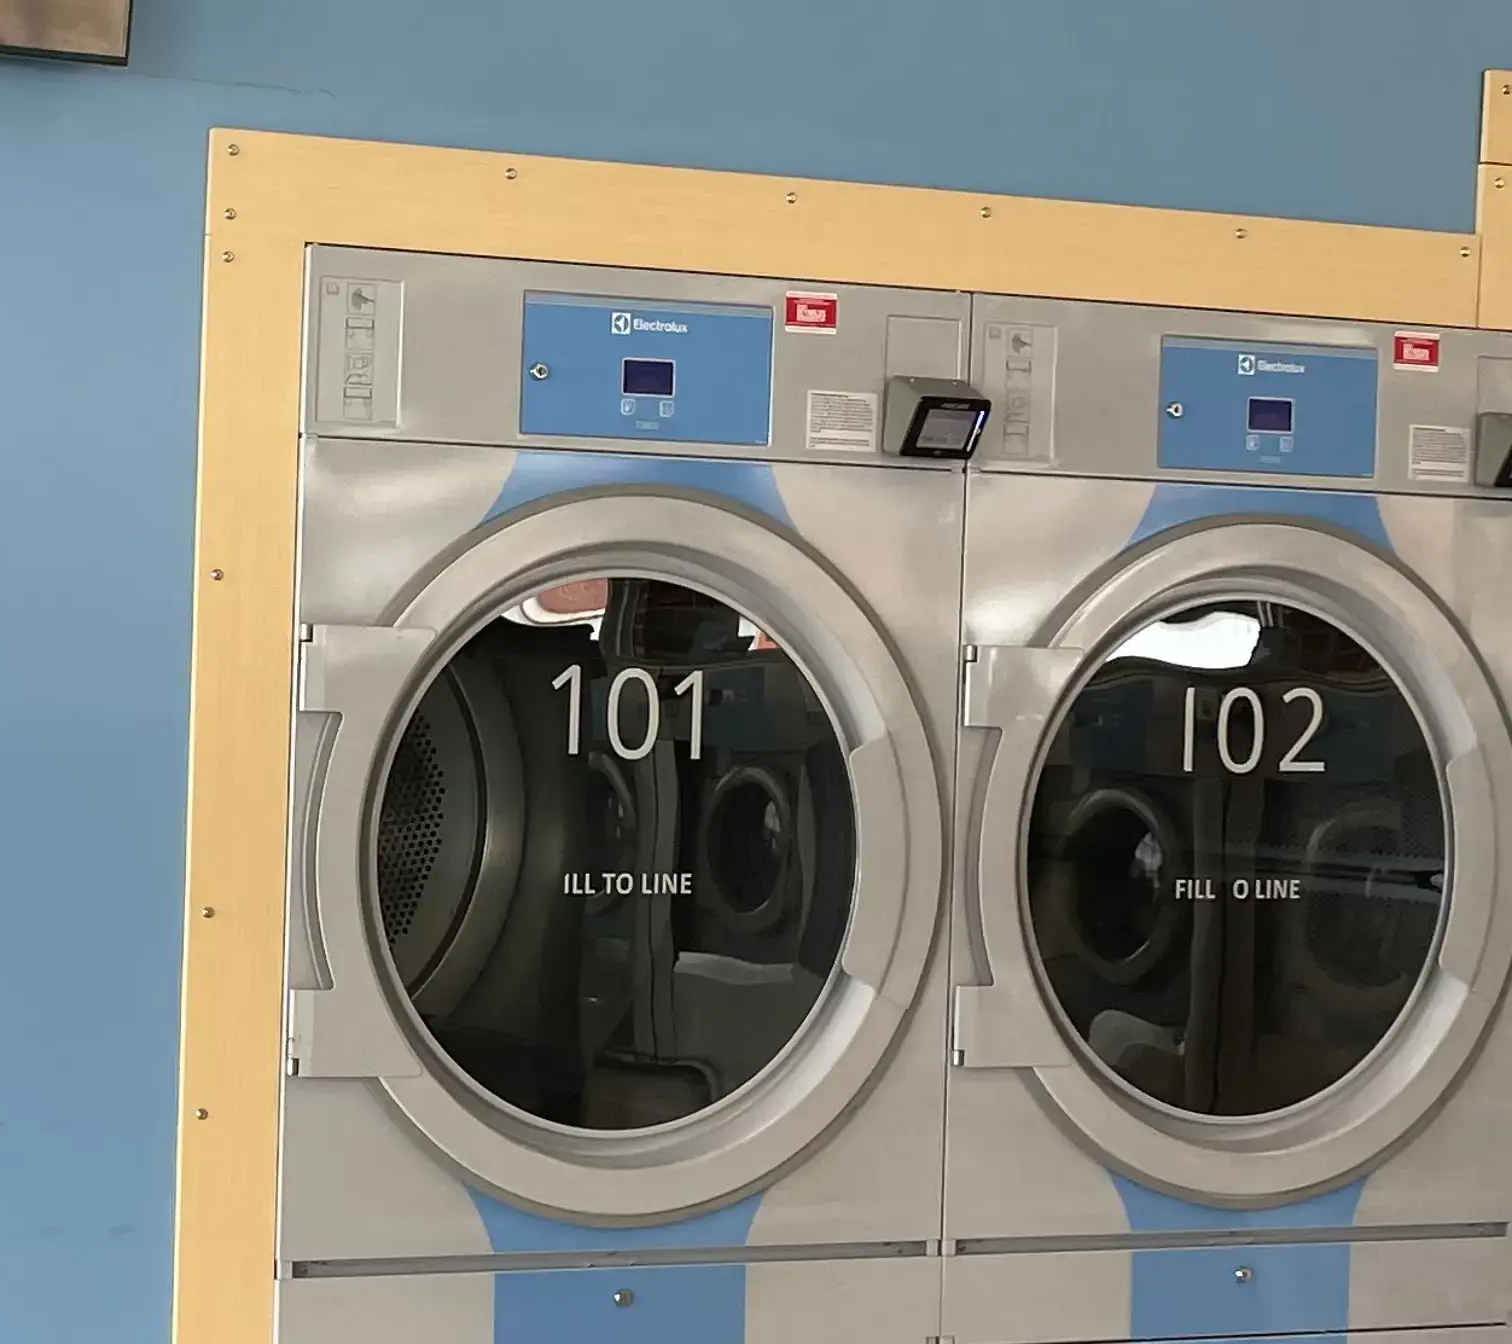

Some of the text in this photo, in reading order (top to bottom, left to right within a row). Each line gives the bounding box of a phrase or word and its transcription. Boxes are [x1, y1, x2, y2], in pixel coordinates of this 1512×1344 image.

[633, 318, 688, 333] Electrolux
[552, 664, 704, 761] 101
[1183, 687, 1325, 774] 102
[601, 873, 634, 895] TO
[641, 873, 693, 895] LINE
[1175, 879, 1216, 899] FILL
[1255, 879, 1301, 899] LINE
